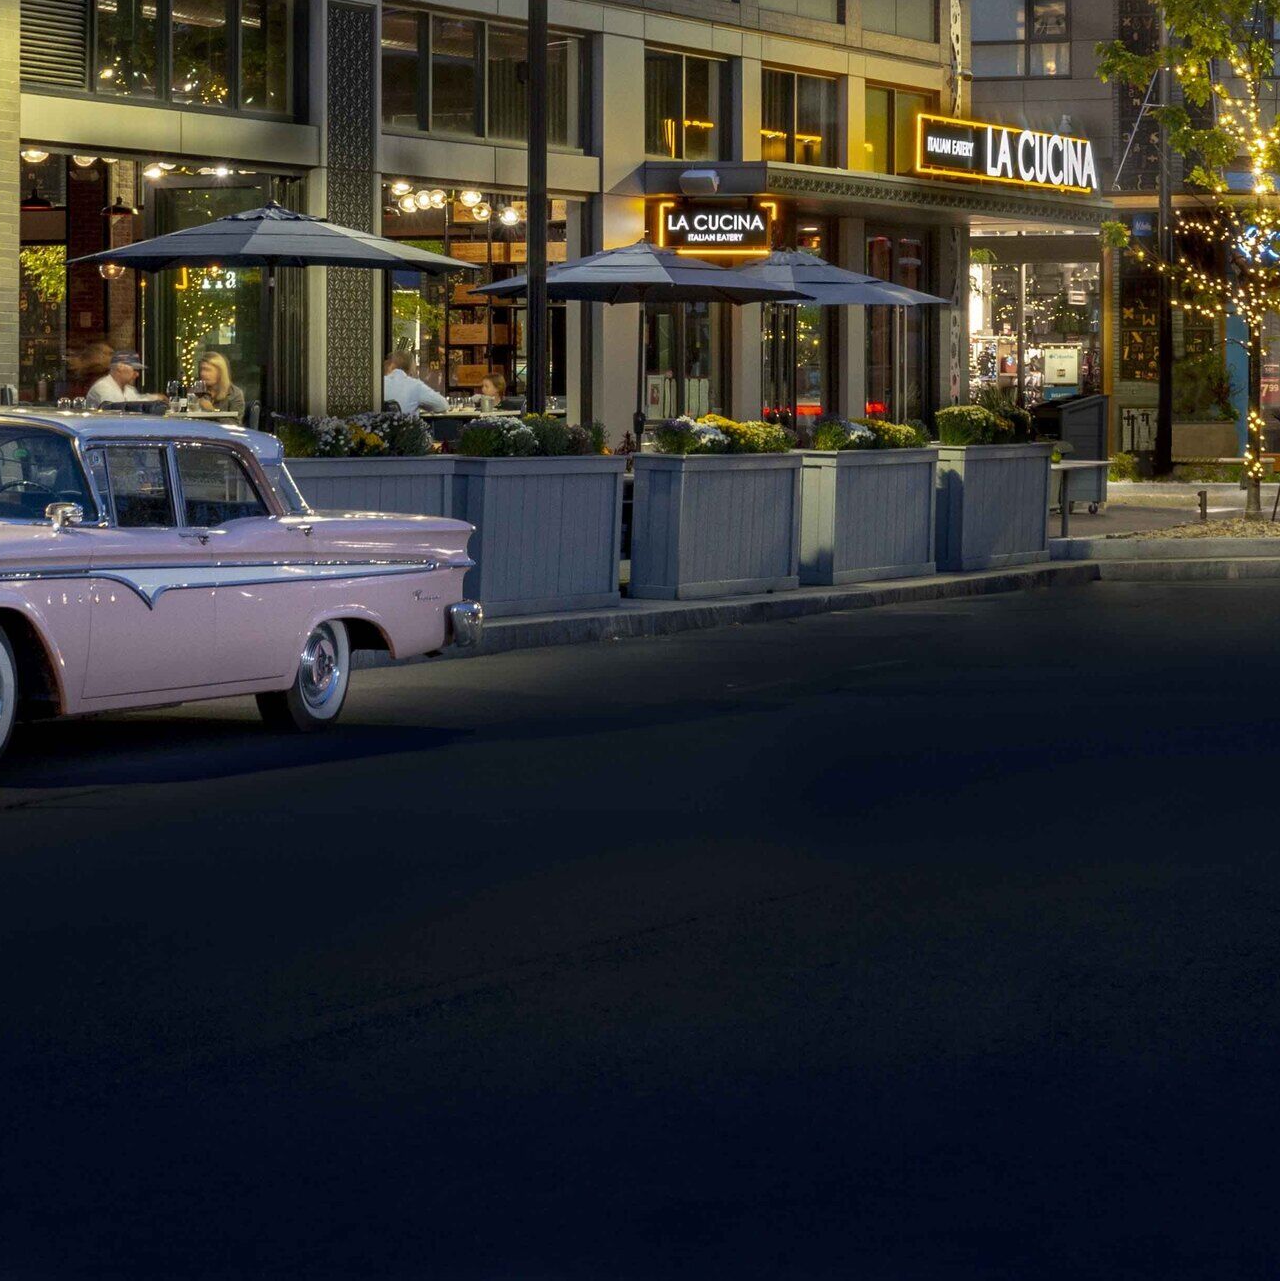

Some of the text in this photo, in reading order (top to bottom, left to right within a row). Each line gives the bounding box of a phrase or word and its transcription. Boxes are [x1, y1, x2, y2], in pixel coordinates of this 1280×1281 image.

[927, 136, 974, 157] ITALIAN EATERY
[987, 126, 1012, 178] LA
[1018, 130, 1097, 189] CUCINA
[668, 215, 764, 230] LA CUCINA
